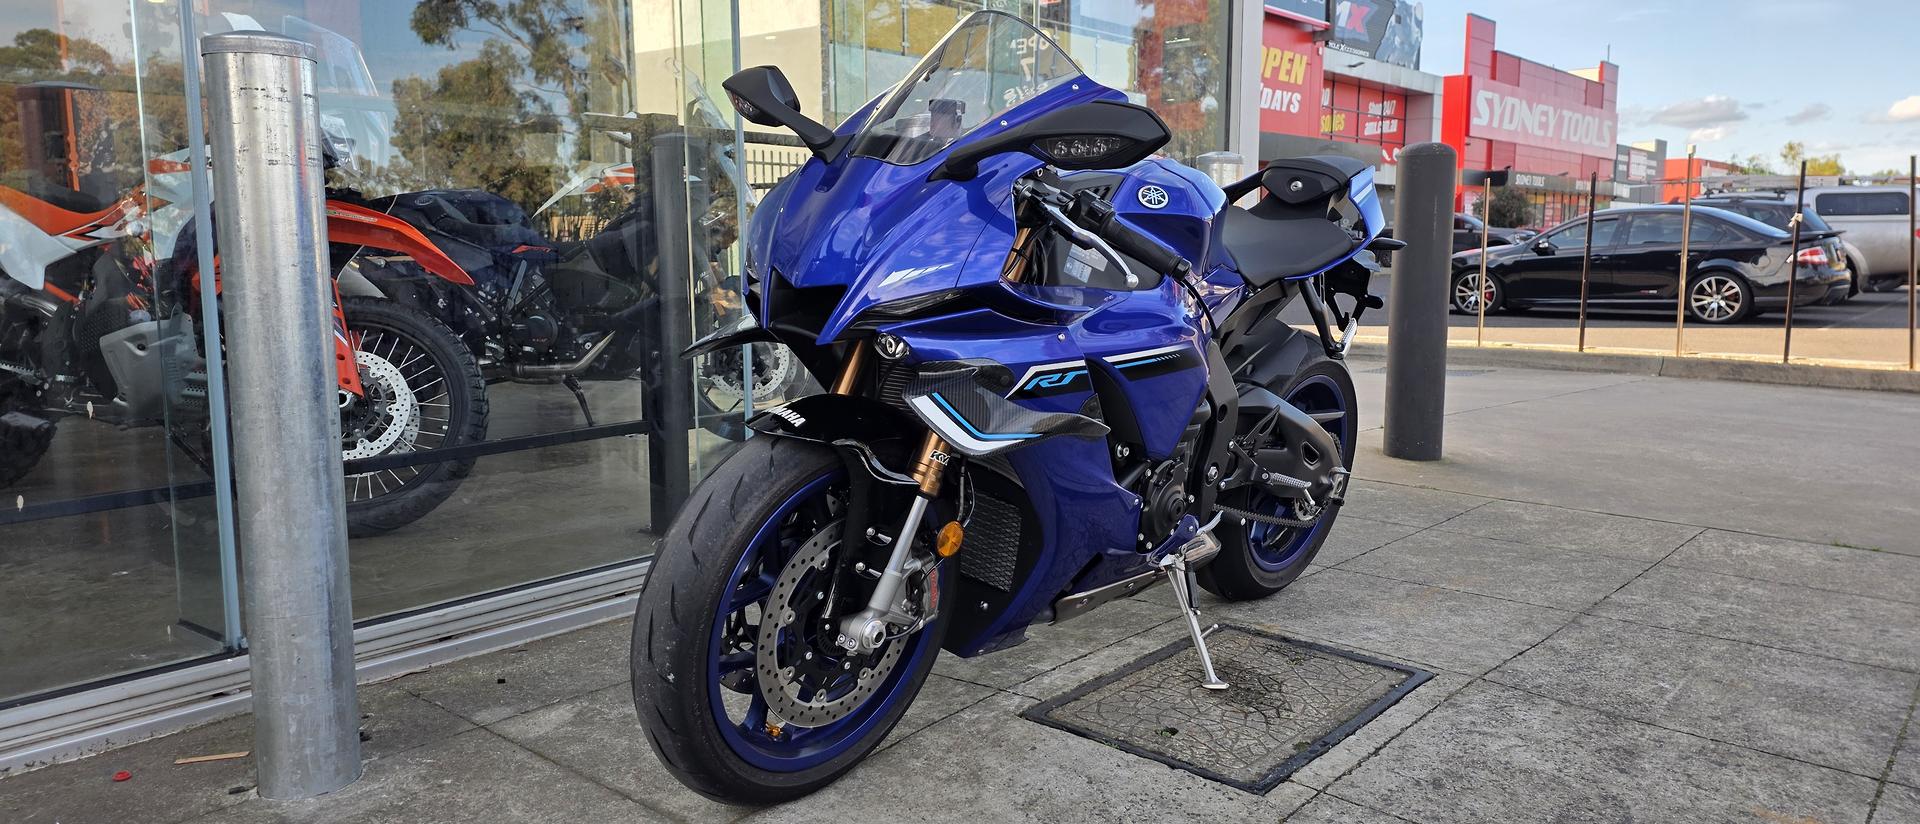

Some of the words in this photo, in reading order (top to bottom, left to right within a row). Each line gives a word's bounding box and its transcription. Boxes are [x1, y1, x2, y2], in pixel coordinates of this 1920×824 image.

[1261, 87, 1301, 113] DAYS
[1472, 89, 1561, 138] SYDNEY
[1561, 110, 1613, 148] TOOLS
[1532, 175, 1546, 187] TOOLS
